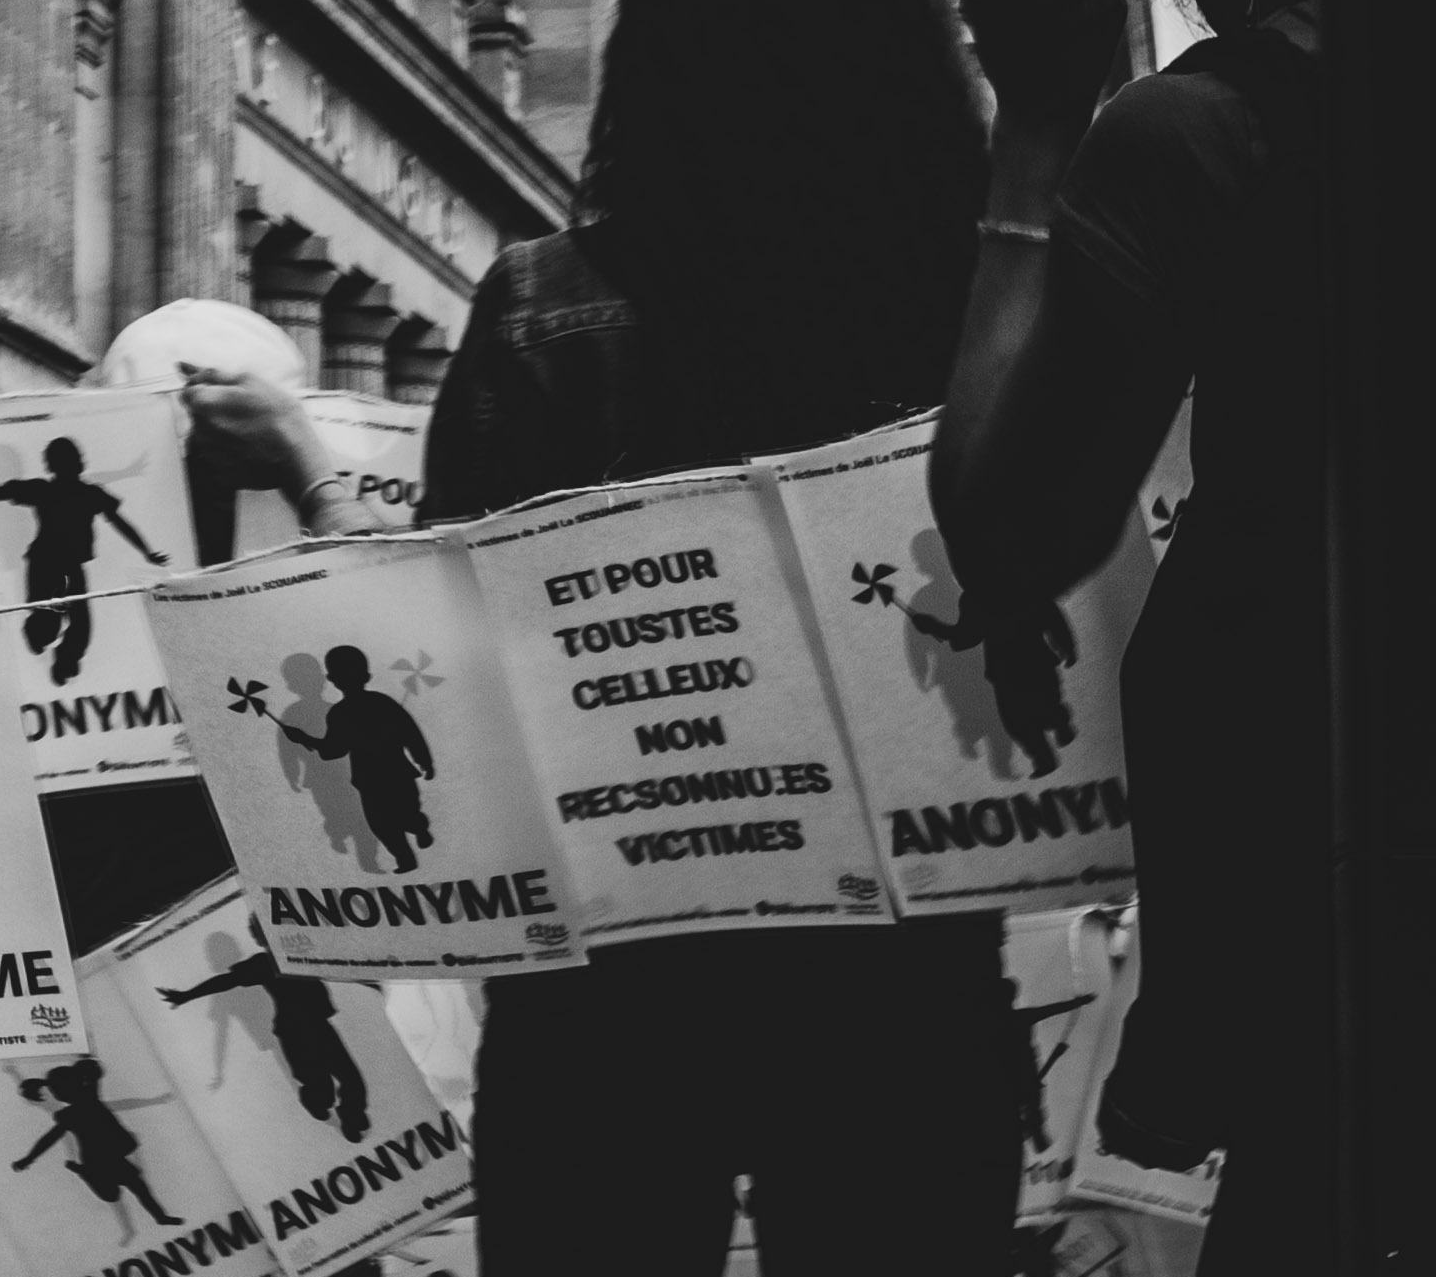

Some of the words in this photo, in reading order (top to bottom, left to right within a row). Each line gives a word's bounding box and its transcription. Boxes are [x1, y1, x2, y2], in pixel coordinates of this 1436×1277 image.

[544, 568, 597, 606] ET
[603, 548, 718, 594] POUR
[553, 601, 739, 658] TOUSTES
[572, 657, 751, 711] CELLEUX
[635, 715, 726, 756] NON
[614, 819, 806, 866] VICTIMES
[269, 869, 557, 928] ANONYME
[269, 1110, 471, 1241] ANONYM
